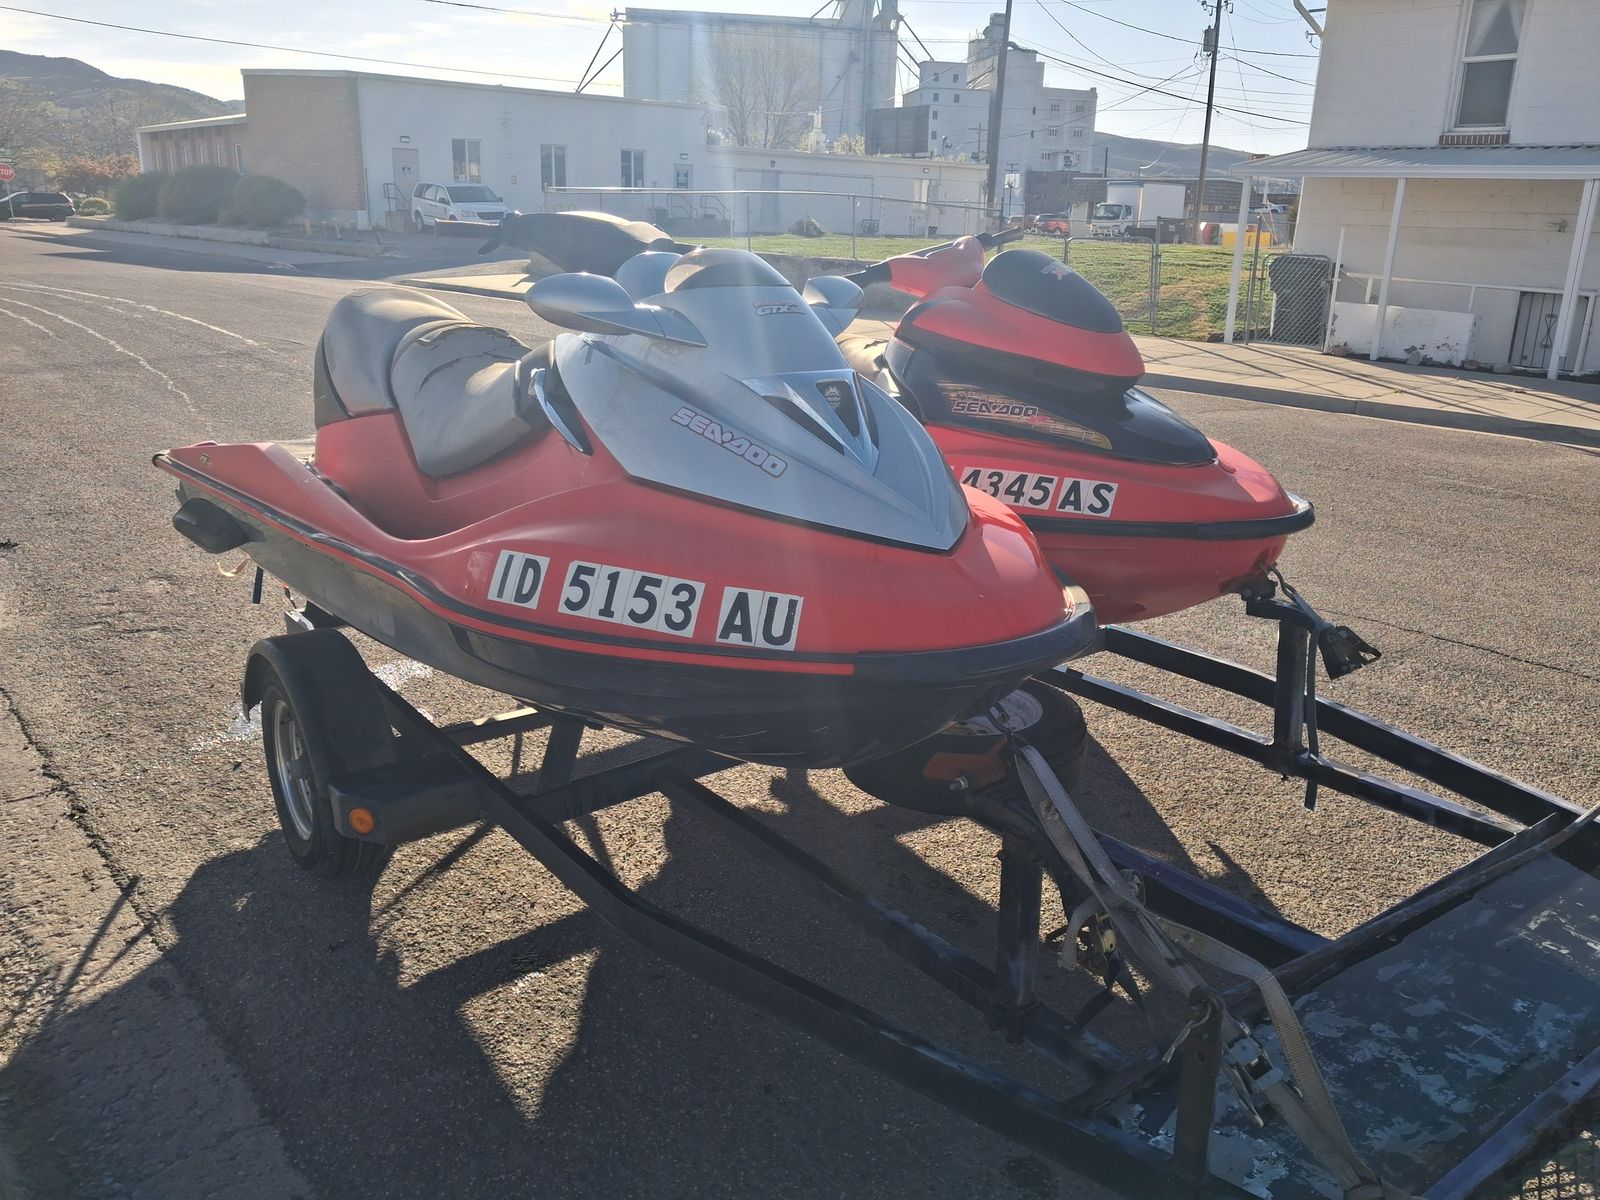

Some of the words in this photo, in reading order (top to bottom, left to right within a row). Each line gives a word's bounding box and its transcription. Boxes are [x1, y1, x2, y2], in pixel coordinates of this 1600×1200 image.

[962, 469, 1055, 506] 4345
[1058, 480, 1114, 514] AS
[496, 554, 542, 604] ID
[563, 564, 697, 632] 5153
[718, 591, 799, 646] AU
